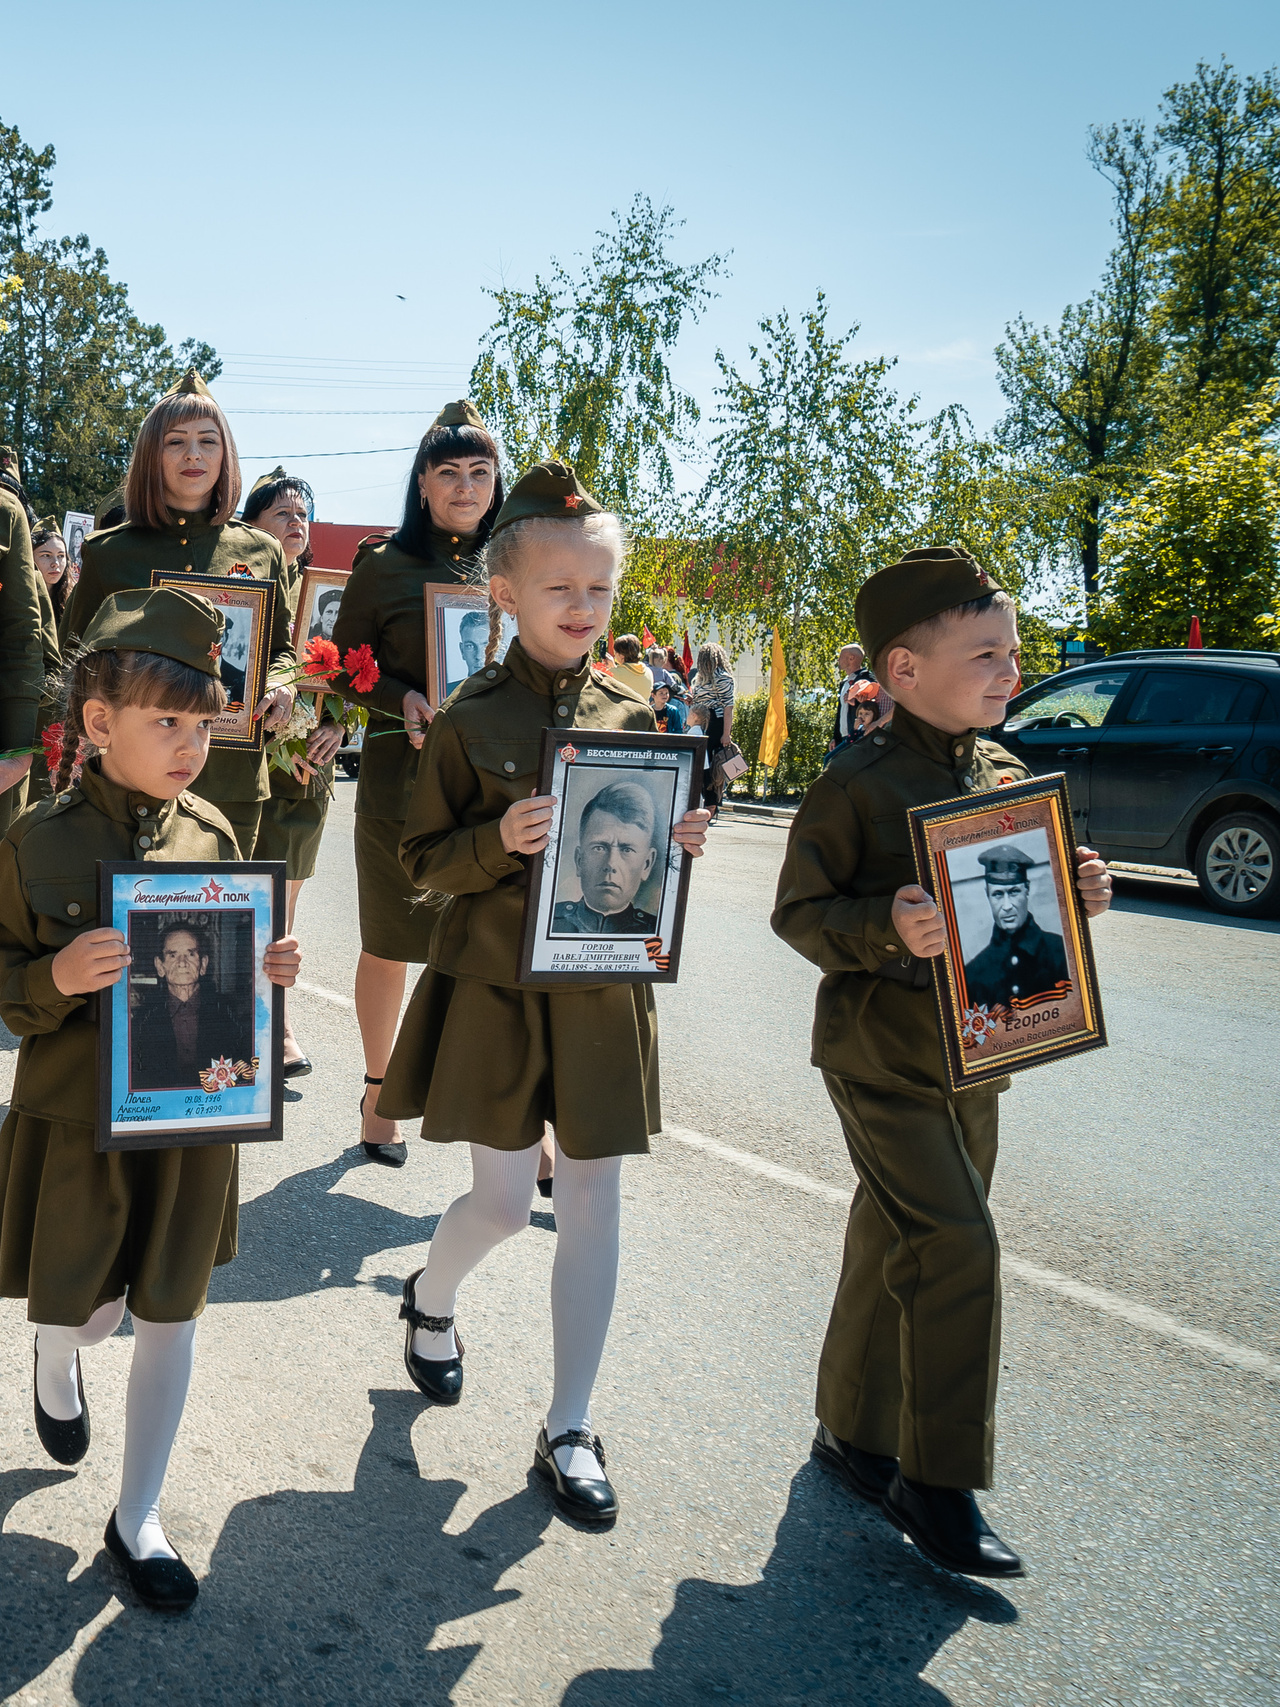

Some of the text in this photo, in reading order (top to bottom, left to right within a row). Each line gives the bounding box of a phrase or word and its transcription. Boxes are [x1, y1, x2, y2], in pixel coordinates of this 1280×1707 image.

[587, 749, 679, 761] БЕССМЕРТНЫЙ ПОЛК
[581, 943, 615, 951] ГОРЛОВ
[552, 953, 641, 962] ПАВЕЛ ДМИТРИЕВИЧ
[550, 963, 588, 971] 05.01.1895
[593, 963, 630, 971] 26.08.1973
[1005, 1007, 1060, 1033] Егоров
[992, 1022, 1076, 1051] Кузьма Васильевич
